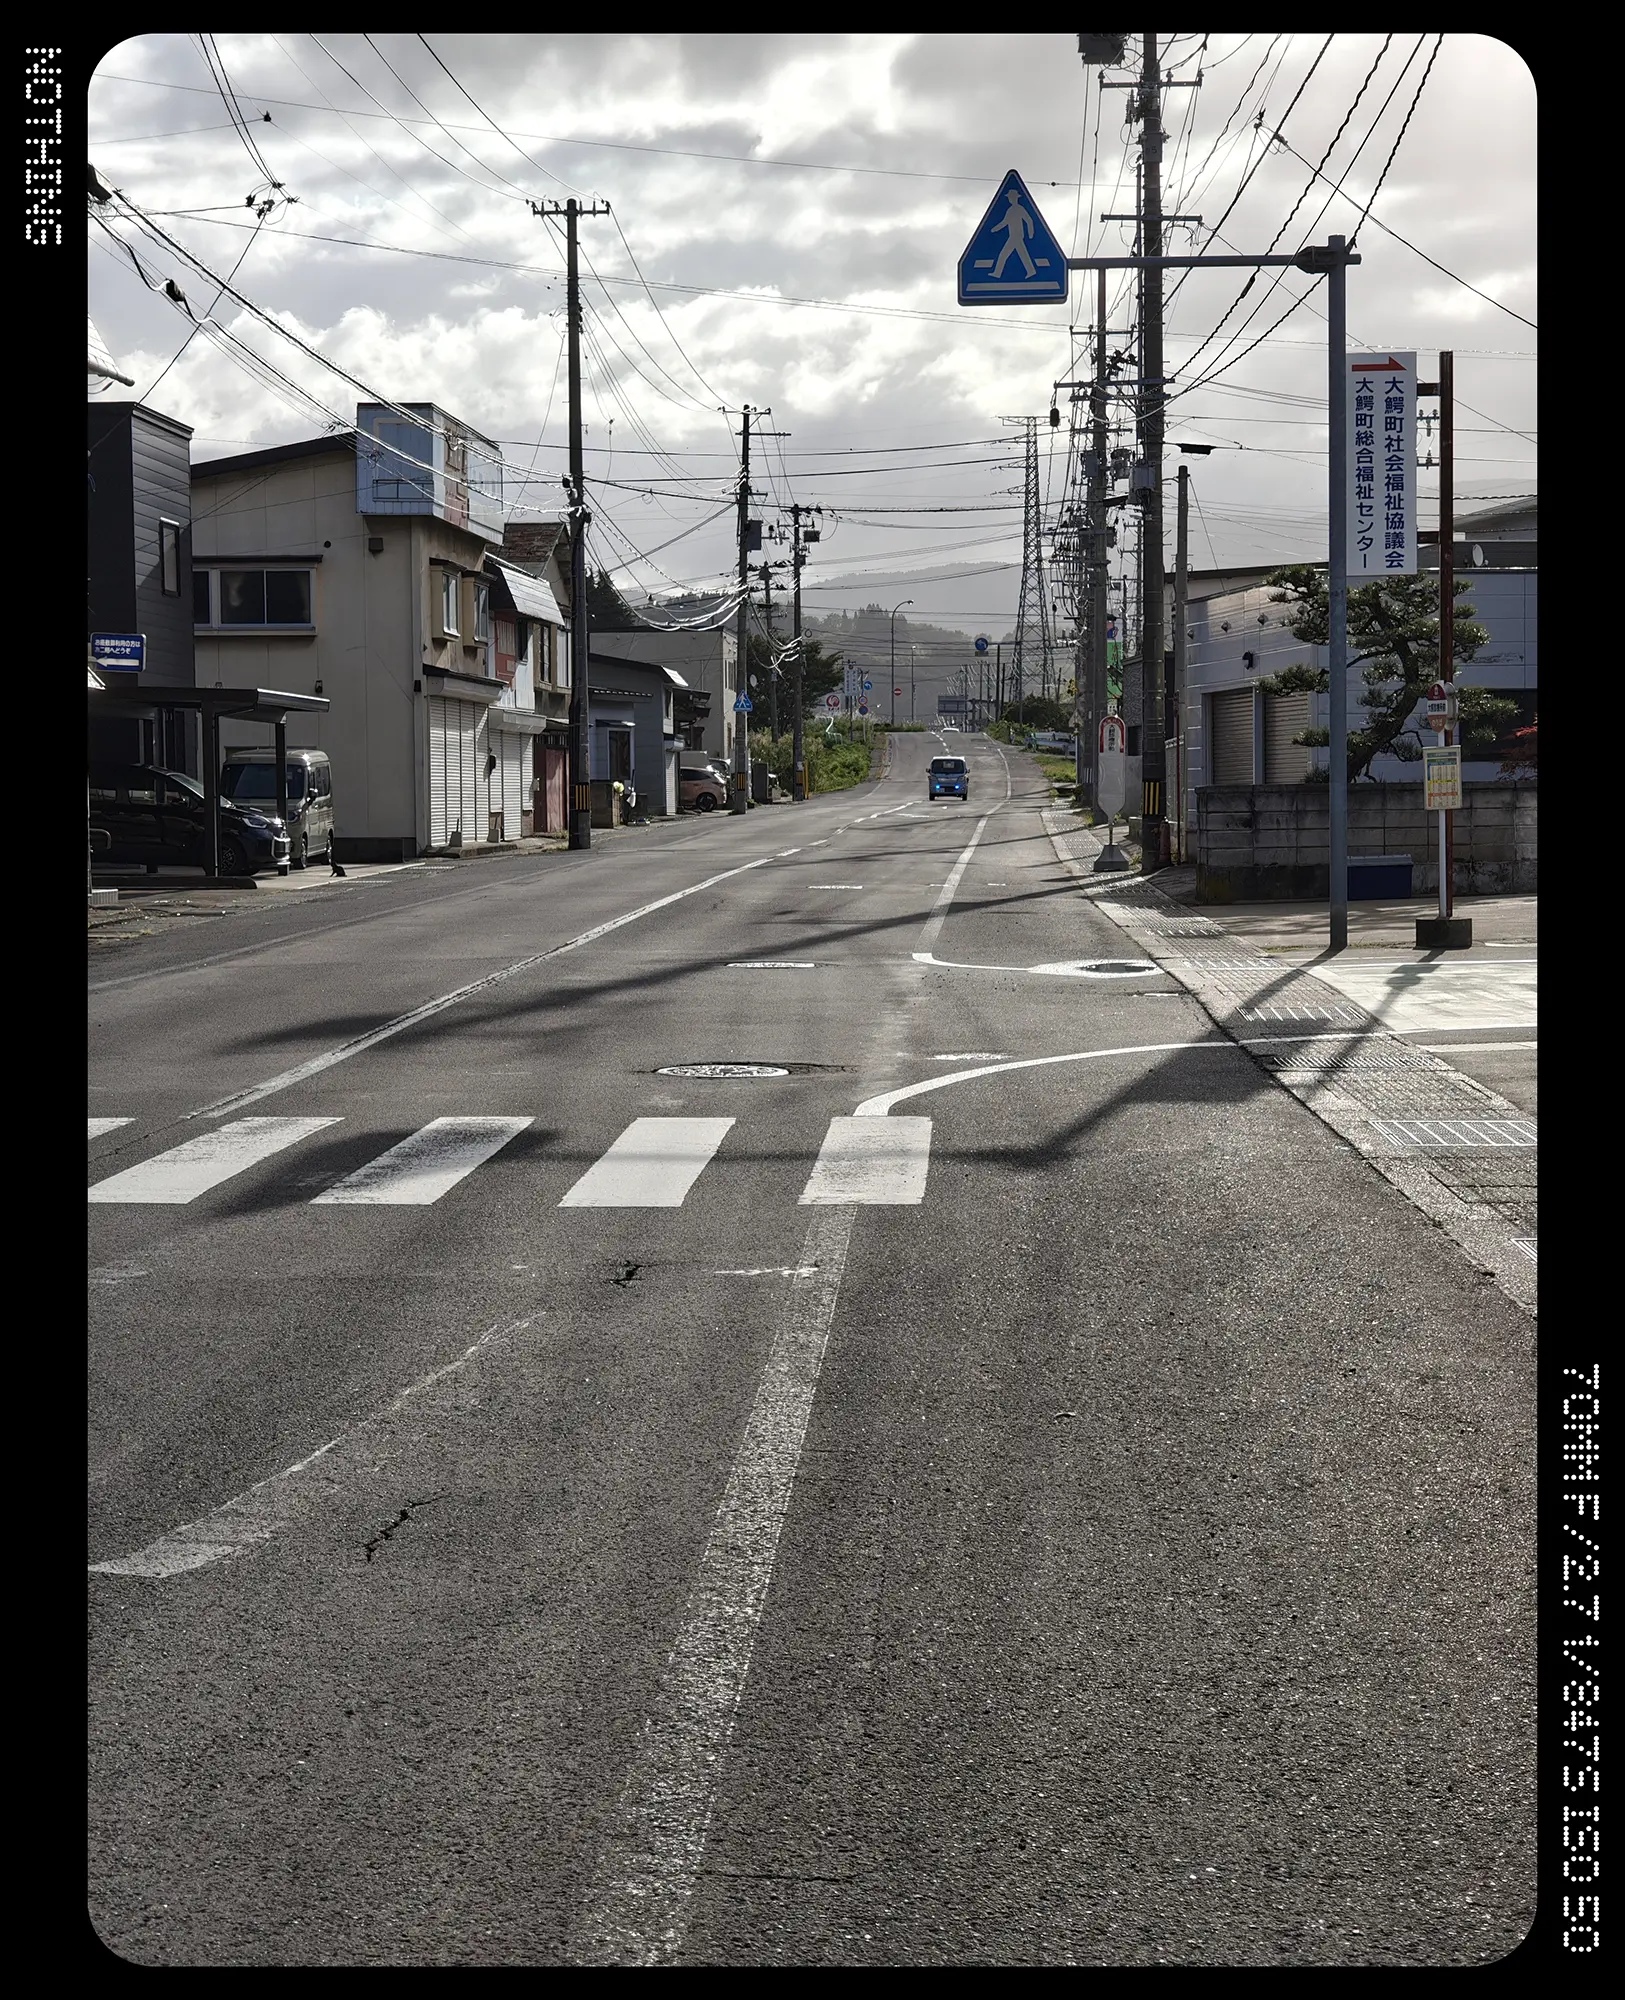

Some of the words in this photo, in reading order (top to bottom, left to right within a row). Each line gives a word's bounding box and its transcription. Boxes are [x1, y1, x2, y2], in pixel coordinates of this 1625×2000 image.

[1355, 377, 1375, 569] 大鰐町総合福祉センター
[1384, 376, 1405, 570] 大鰐町社会福祉協議会
